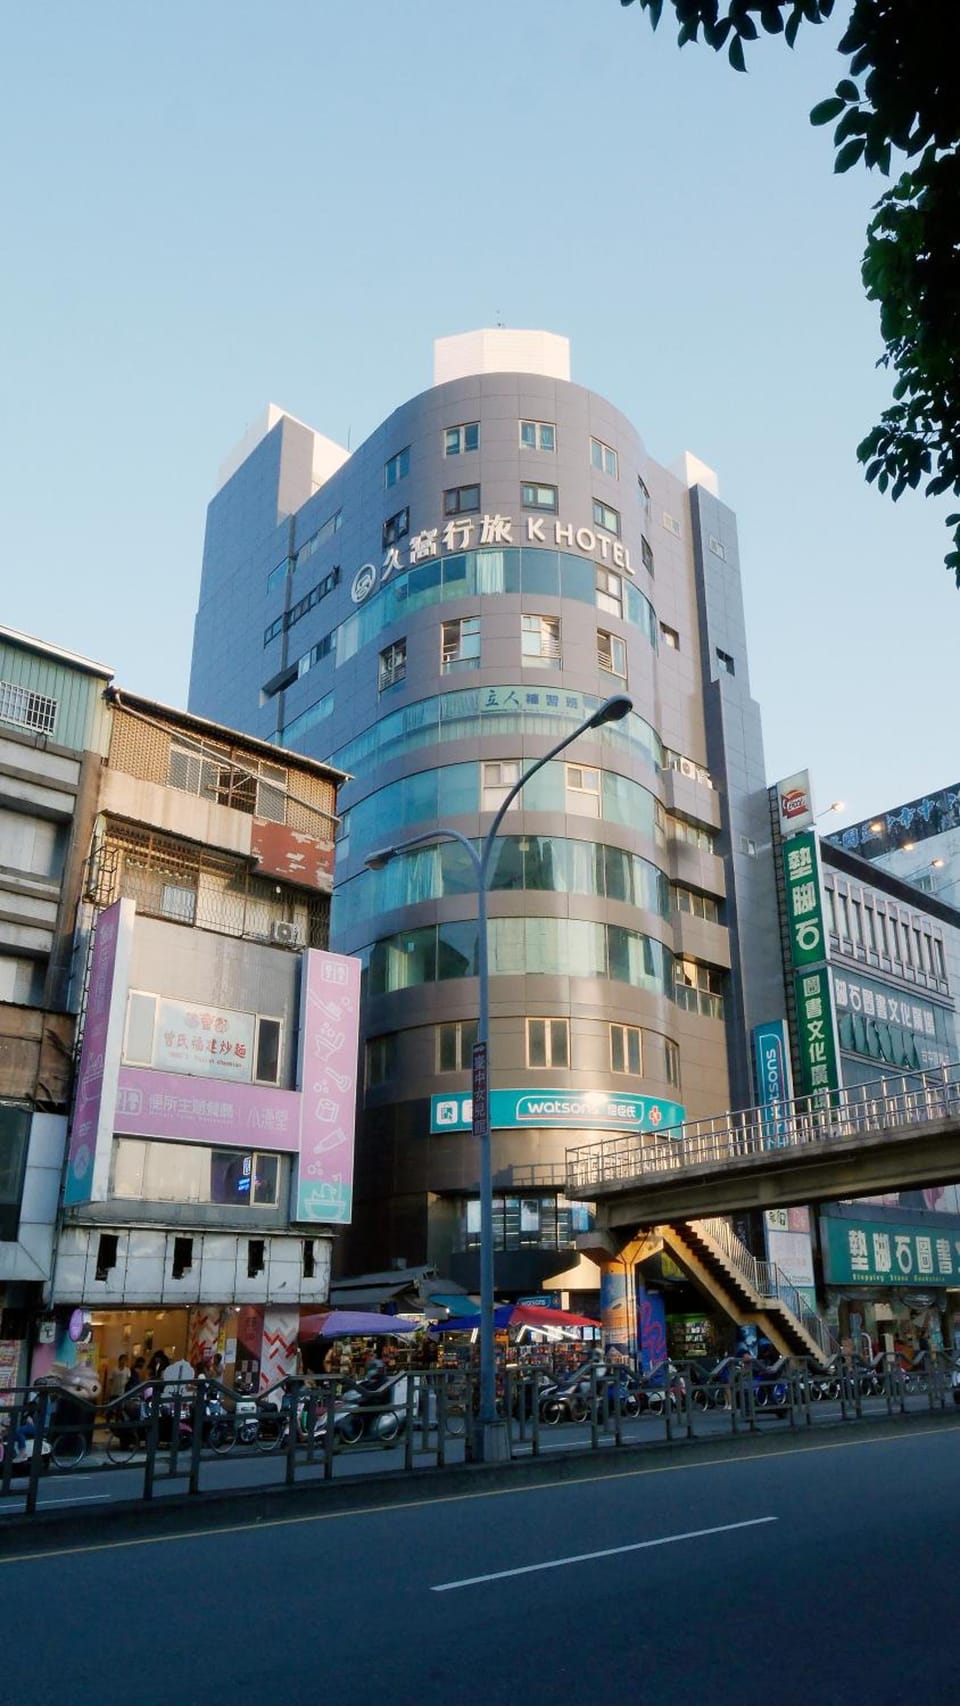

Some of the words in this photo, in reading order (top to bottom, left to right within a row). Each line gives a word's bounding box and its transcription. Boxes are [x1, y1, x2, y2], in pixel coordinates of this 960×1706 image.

[380, 514, 513, 582] 久窩行旅
[528, 517, 546, 542] K
[555, 521, 636, 575] HOTEL
[787, 846, 820, 951] 墊腳石
[607, 1103, 637, 1118] 屈臣氏
[848, 1229, 960, 1275] 墊腳石圖書
